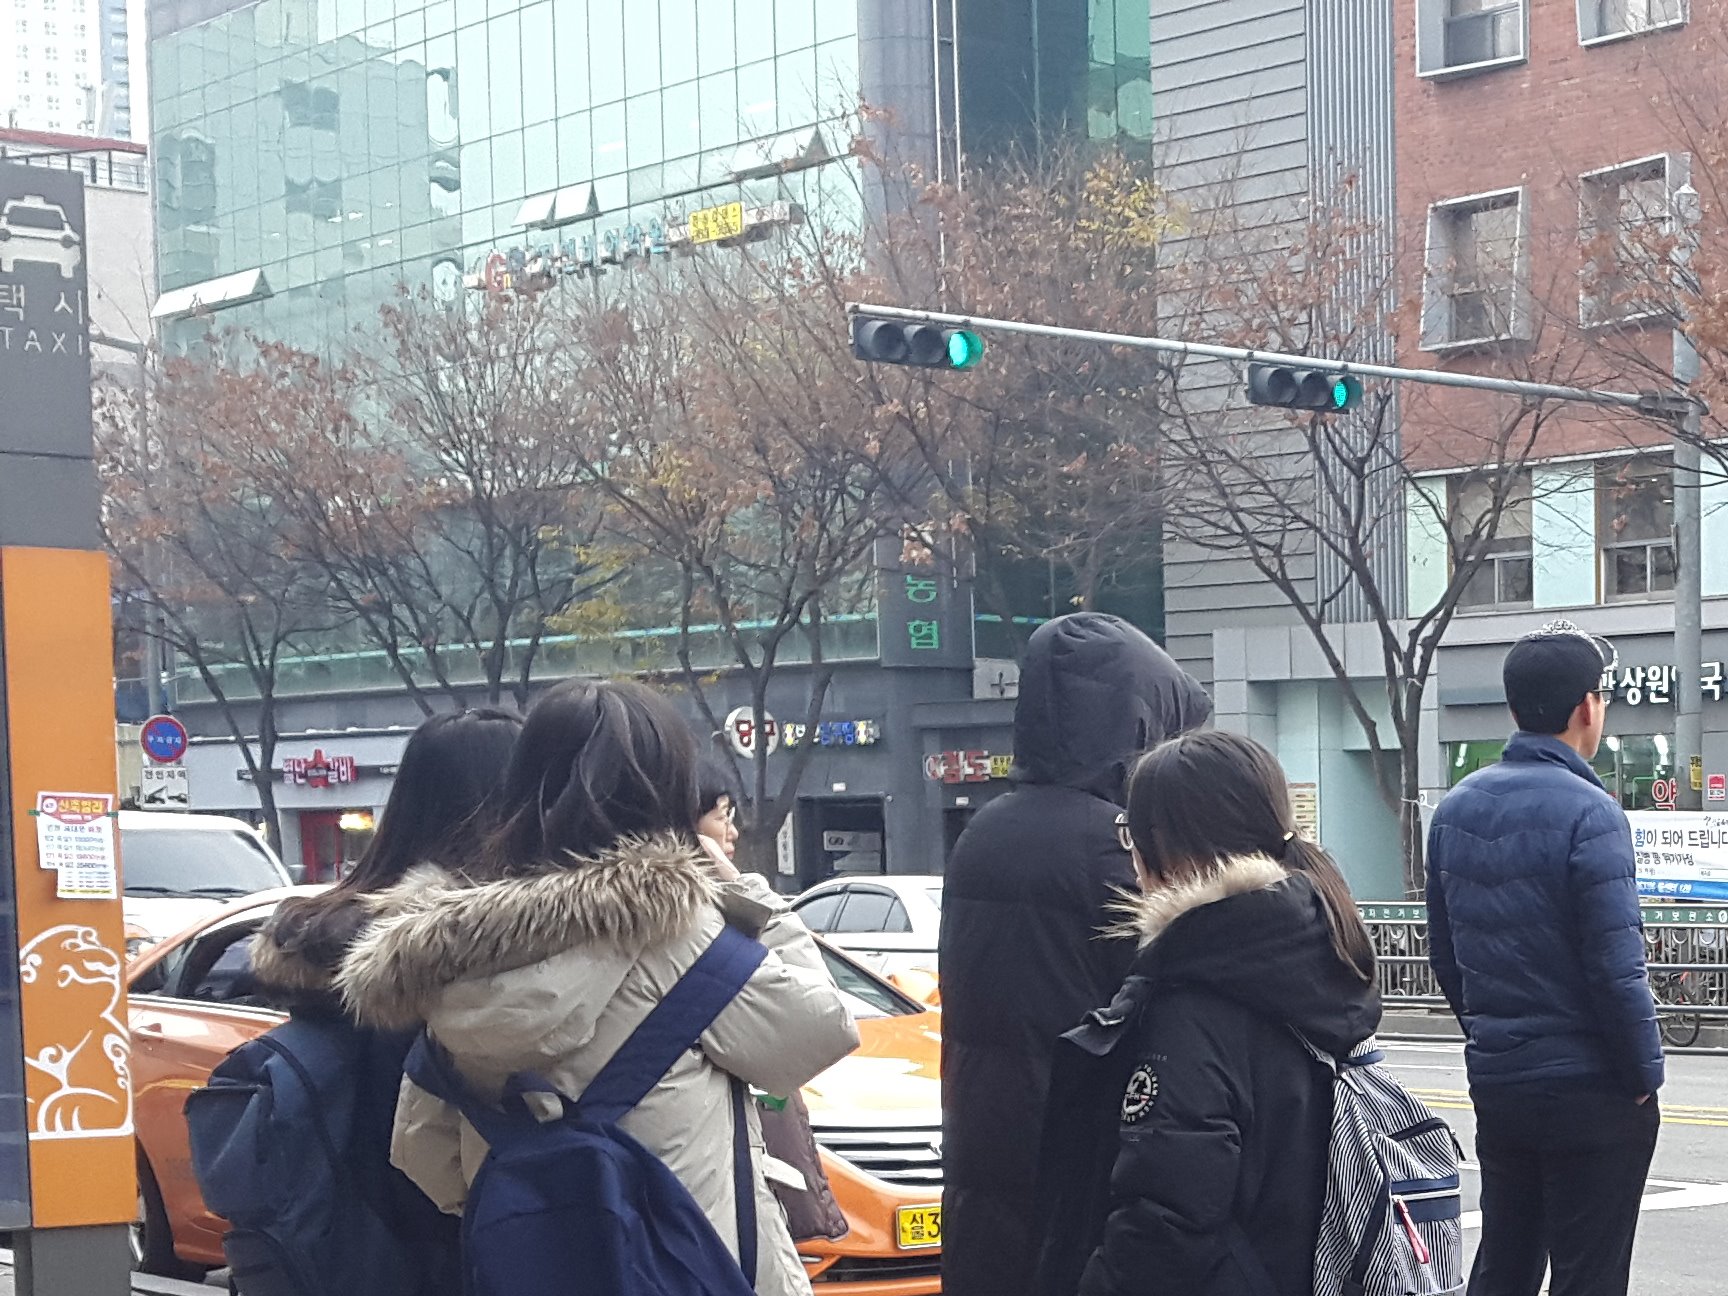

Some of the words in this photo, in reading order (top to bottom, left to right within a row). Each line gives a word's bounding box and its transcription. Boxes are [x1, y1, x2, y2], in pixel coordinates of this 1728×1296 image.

[0, 284, 83, 326] 택시
[0, 326, 83, 356] TAXI
[1634, 828, 1657, 848] 힘이
[1661, 829, 1683, 848] 되어
